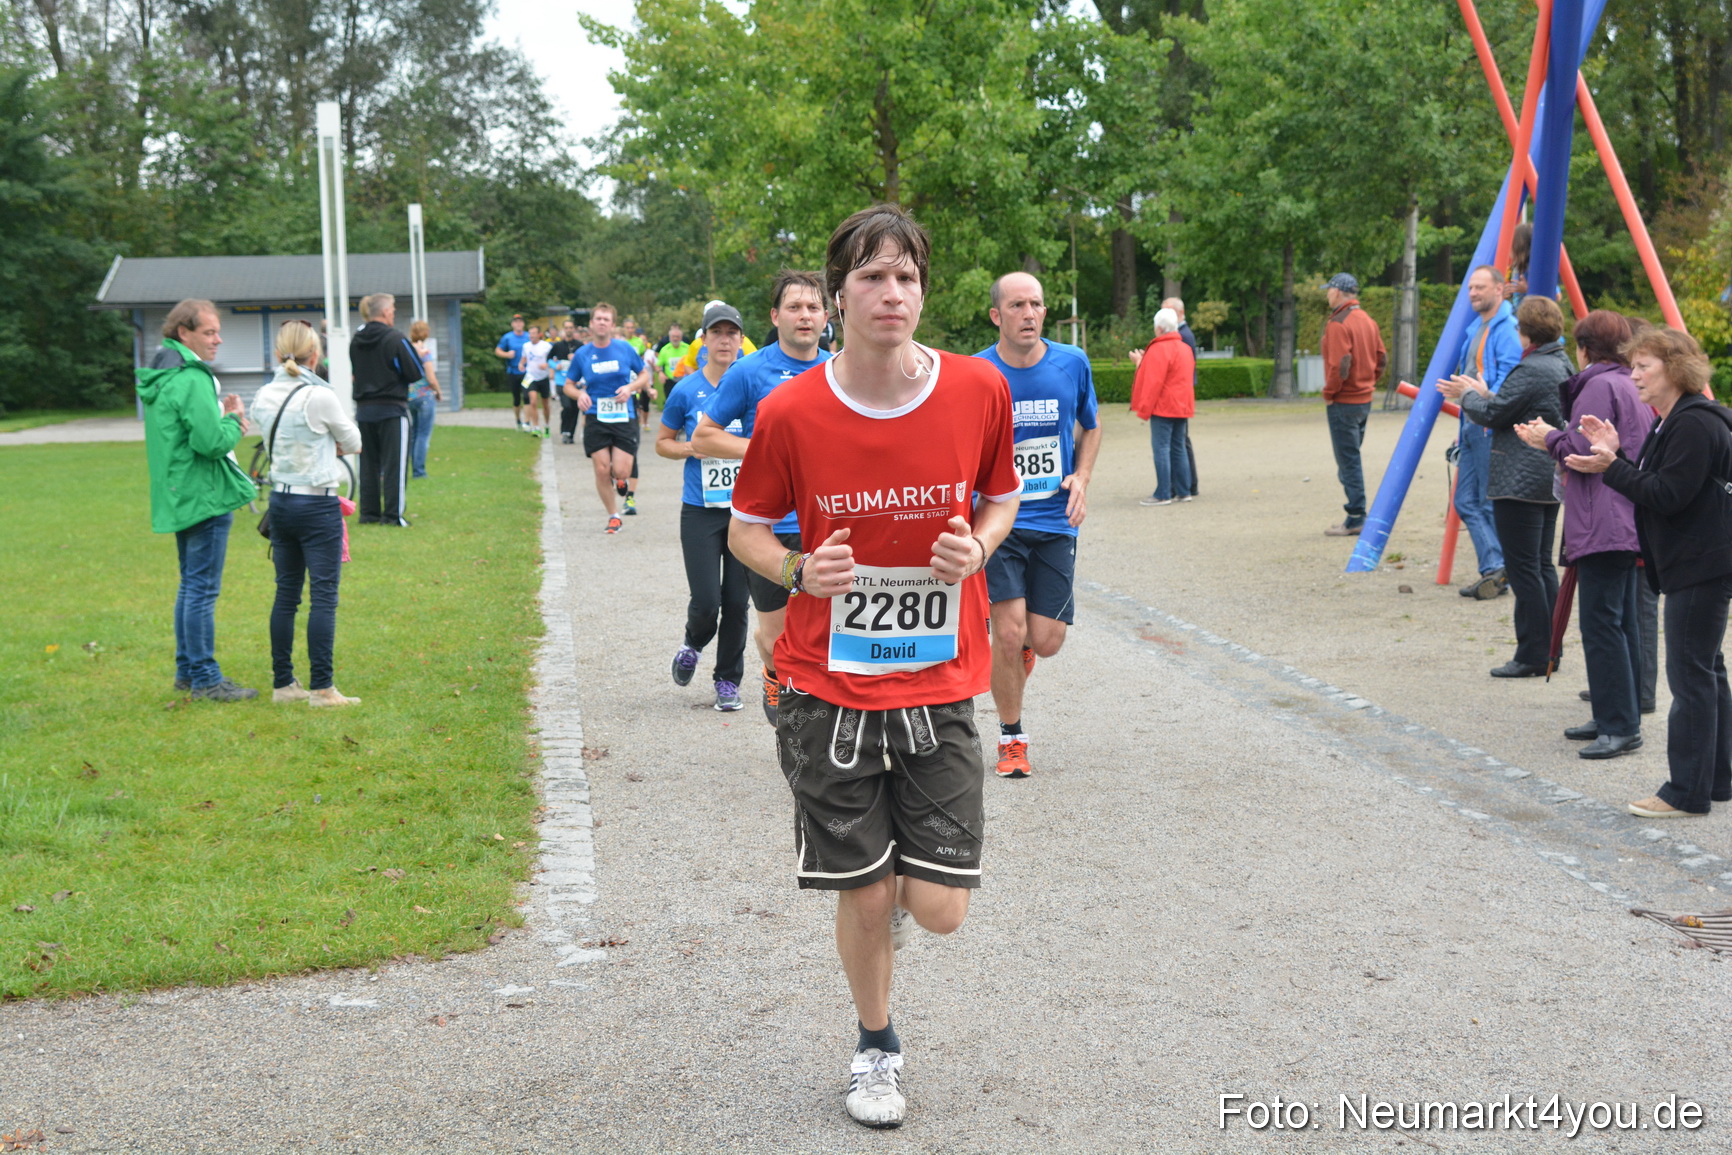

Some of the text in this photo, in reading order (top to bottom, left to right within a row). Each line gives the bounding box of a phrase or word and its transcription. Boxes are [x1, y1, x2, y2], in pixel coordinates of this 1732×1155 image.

[1012, 399, 1059, 415] UBER
[1015, 443, 1048, 452] Neumarkt
[1014, 452, 1055, 477] 885
[815, 484, 950, 514] NEUMARKT
[893, 510, 950, 521] STARKE STADT
[852, 576, 940, 587] RTL Neumarkt
[844, 590, 948, 632] 2280
[870, 642, 916, 659] David
